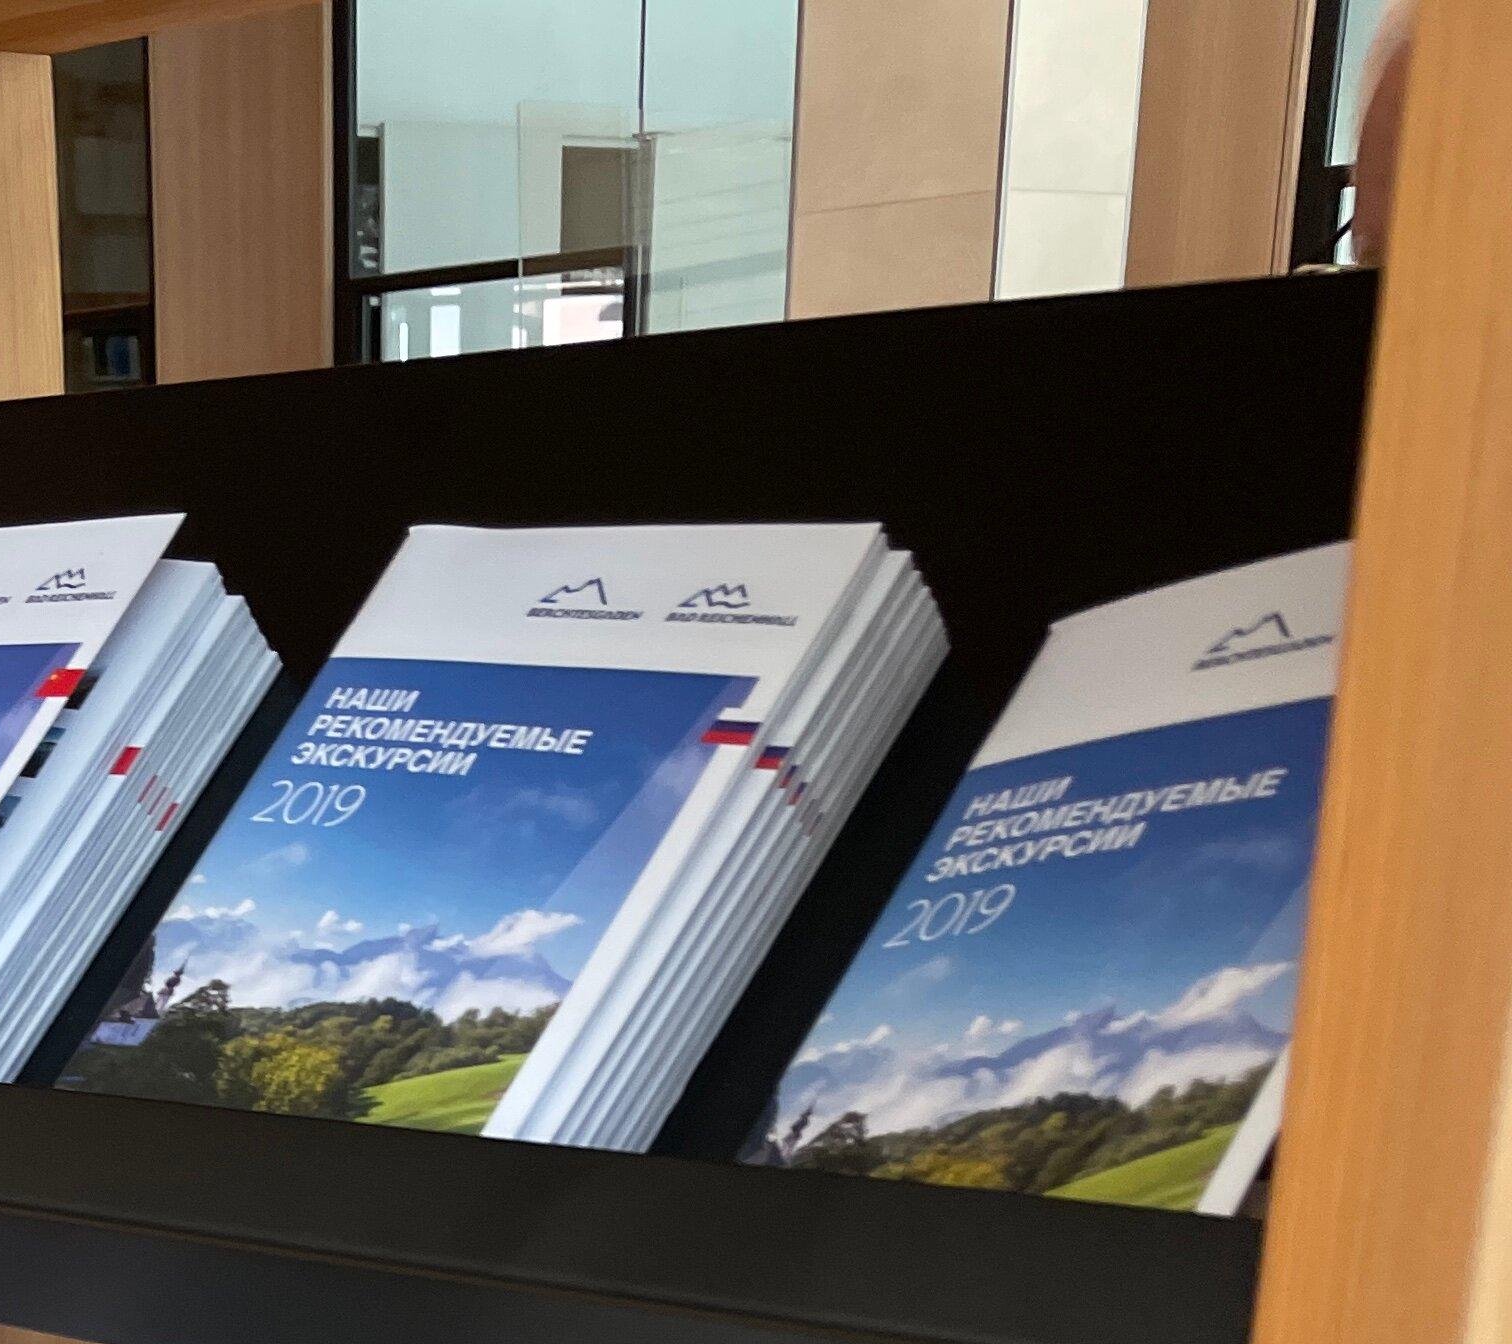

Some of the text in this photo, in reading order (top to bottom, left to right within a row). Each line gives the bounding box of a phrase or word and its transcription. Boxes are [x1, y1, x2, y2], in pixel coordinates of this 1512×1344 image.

[326, 687, 421, 713] НАШИ
[307, 715, 593, 756] РЕКОМЕНДУЕМЫЕ
[291, 743, 477, 776] ЭКСКУРСИИ
[250, 780, 366, 827] 2019
[944, 768, 1288, 852] РЕКОМЕНДУЕМЫЕ
[964, 776, 1073, 820] НАШИ
[925, 823, 1147, 883] ЭКСКУРСИИ
[882, 884, 1017, 948] 2019
